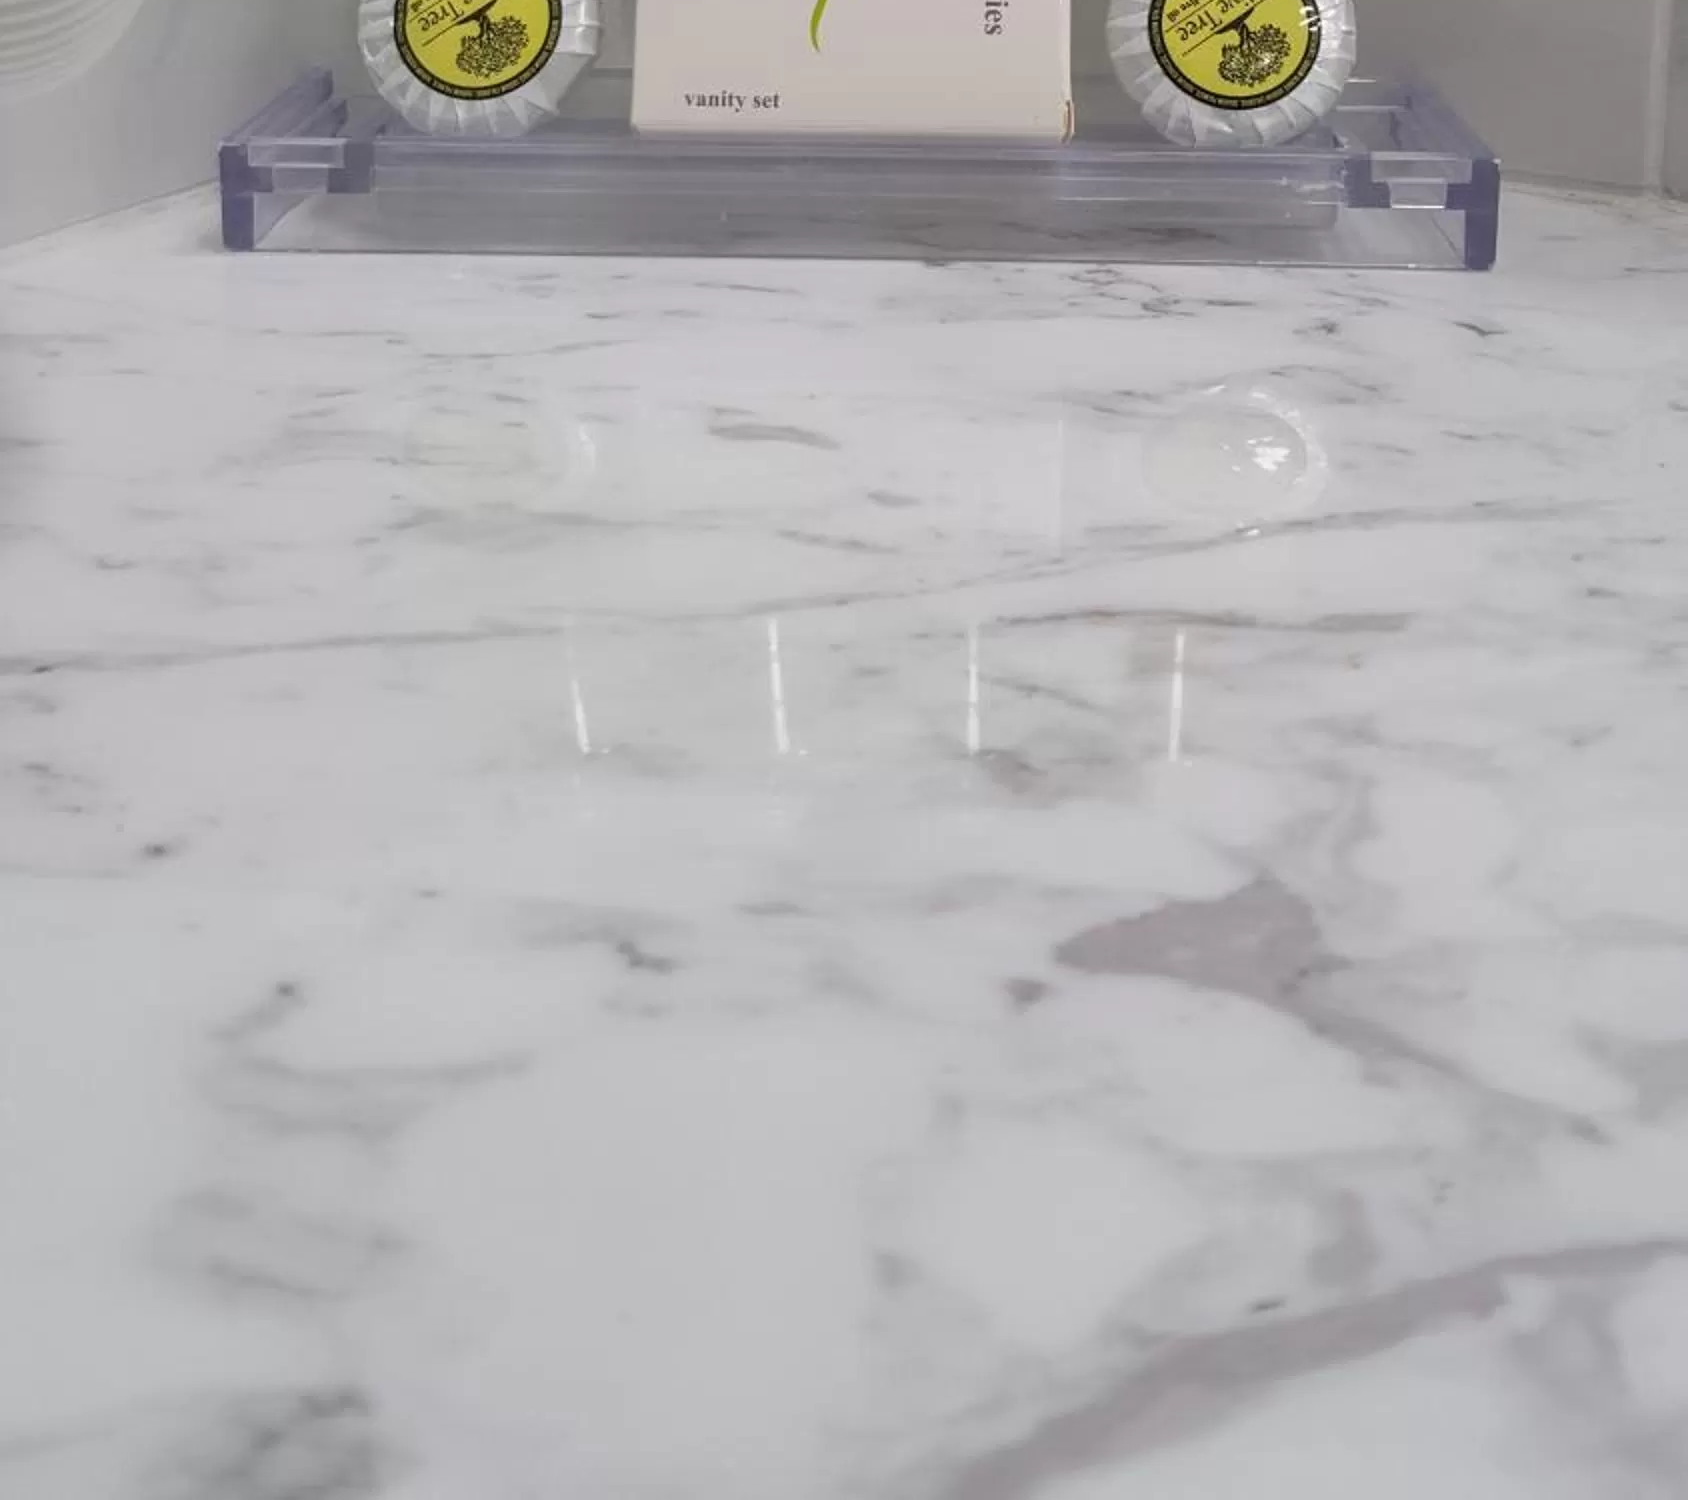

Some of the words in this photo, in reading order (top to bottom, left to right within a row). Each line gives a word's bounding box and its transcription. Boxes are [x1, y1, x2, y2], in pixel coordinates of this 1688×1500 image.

[1178, 10, 1224, 42] Tree
[684, 90, 746, 113] vanity
[752, 91, 780, 110] set
